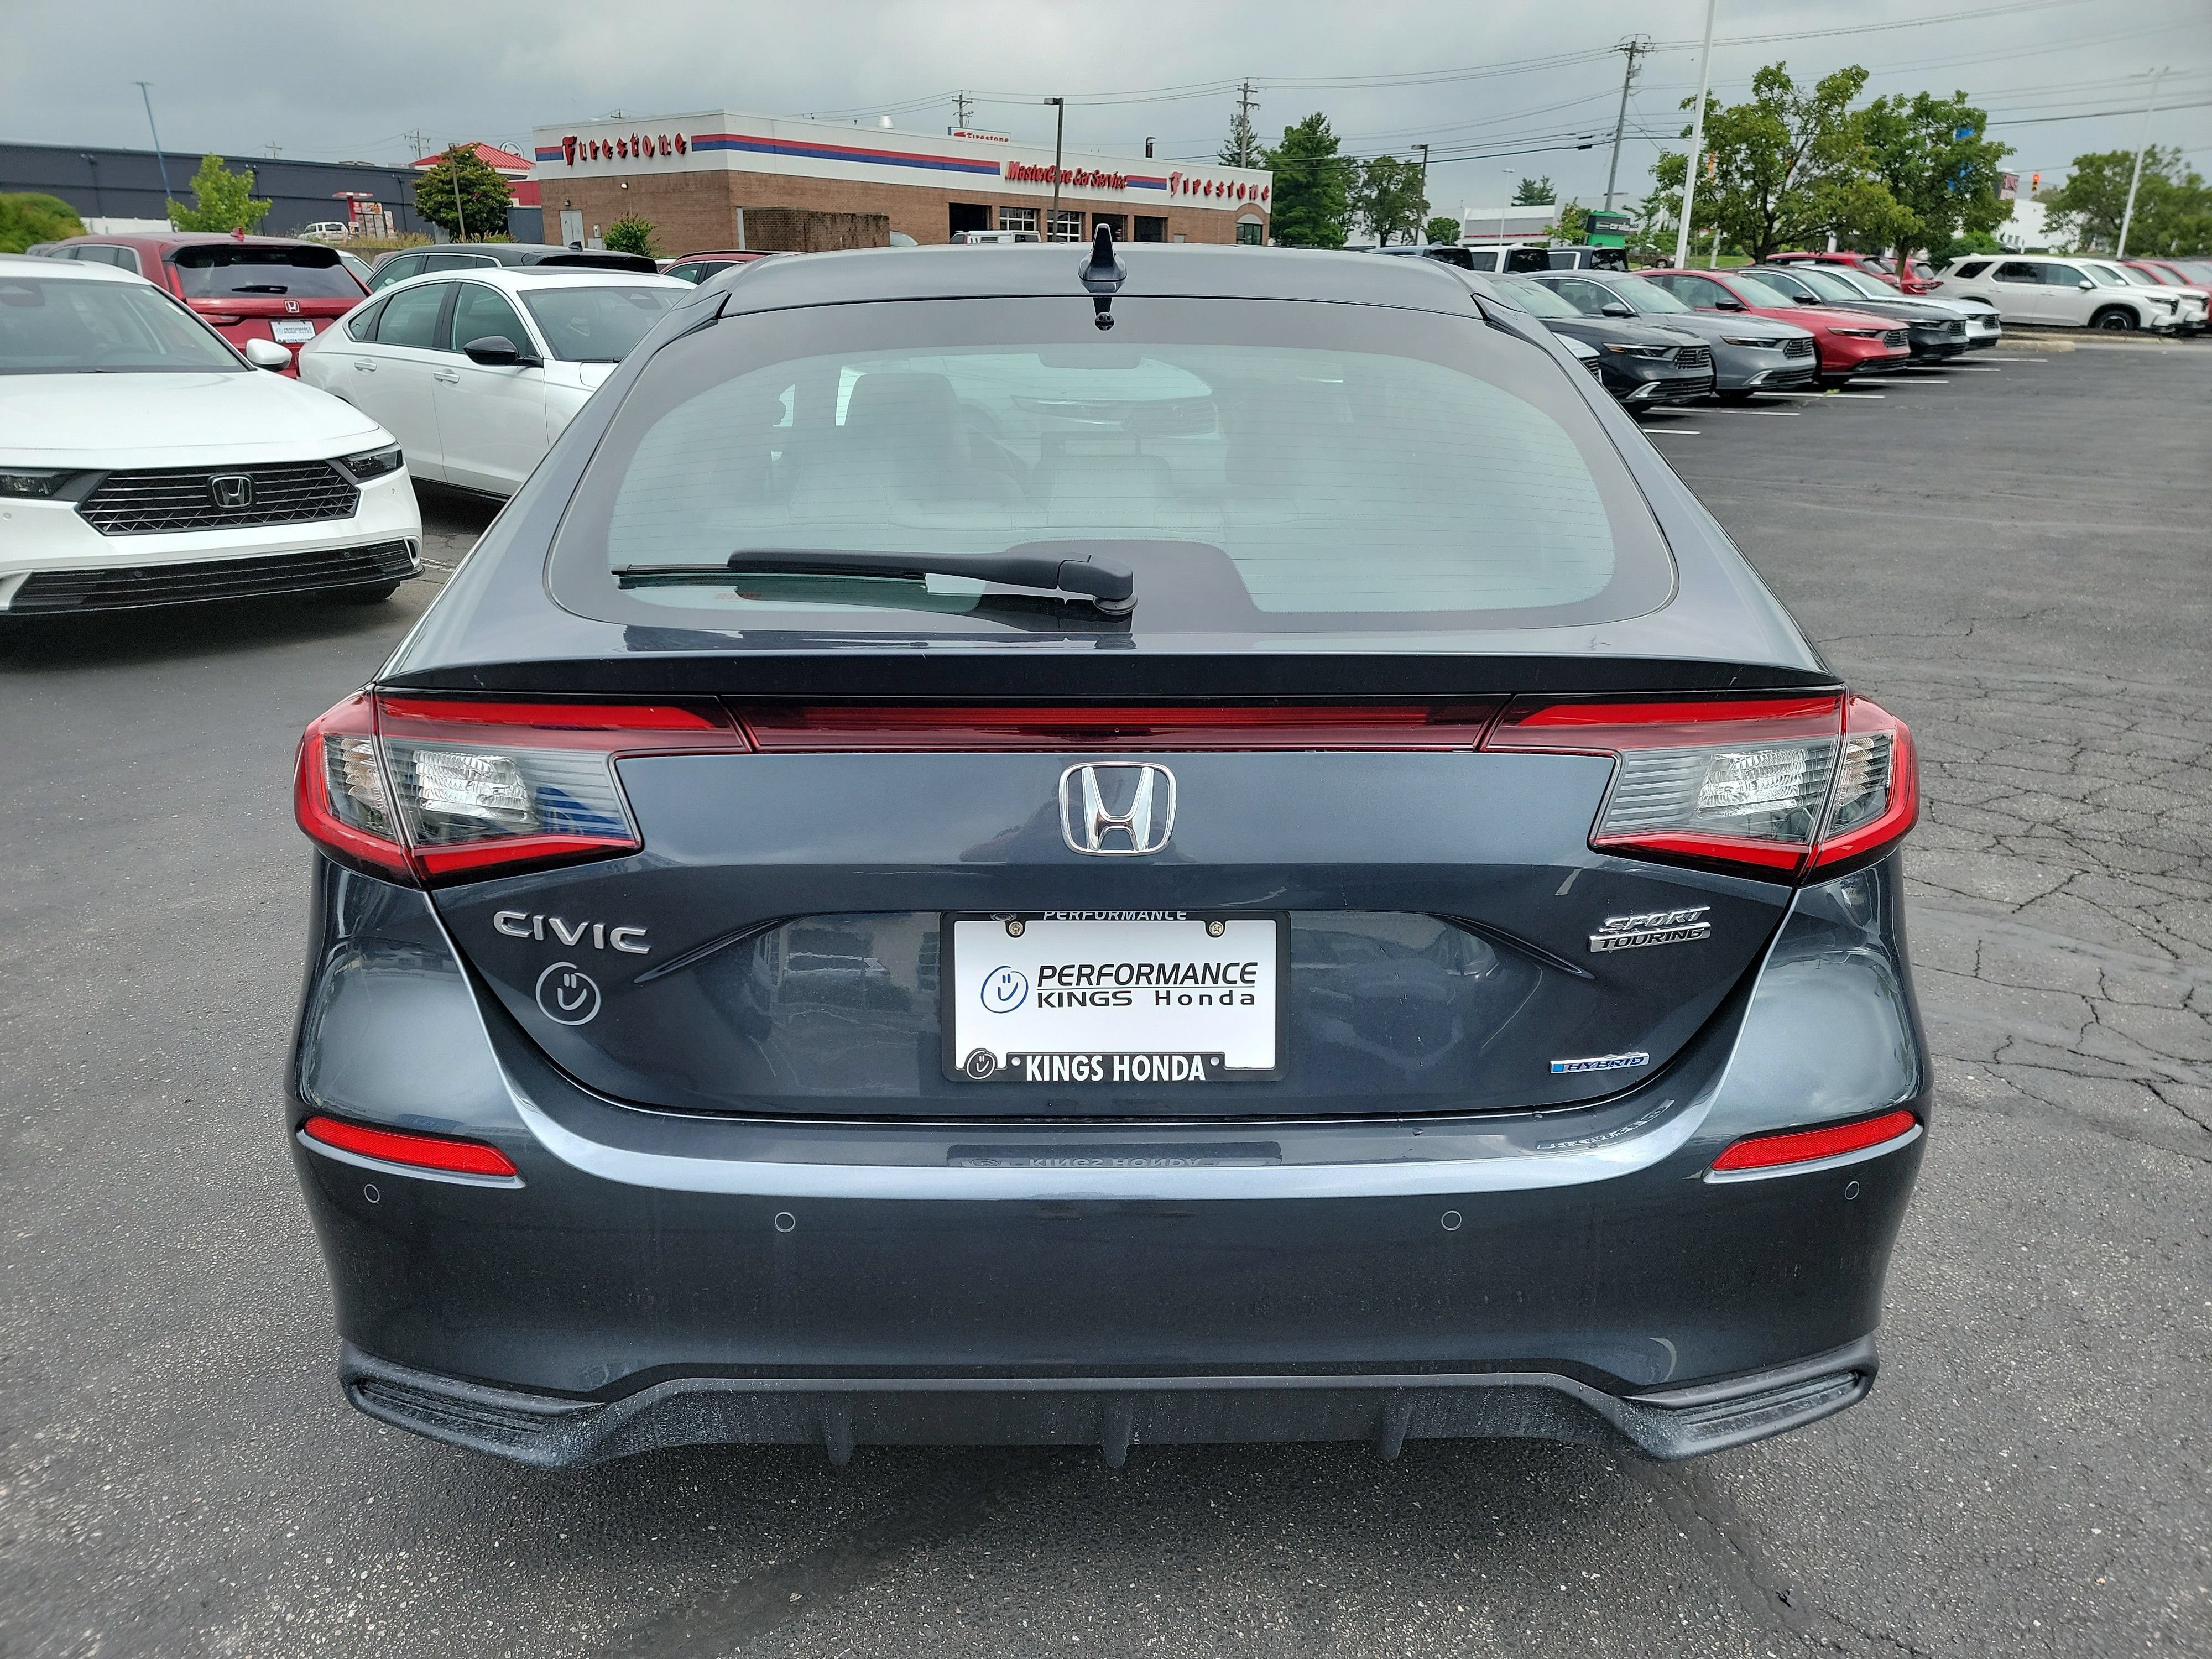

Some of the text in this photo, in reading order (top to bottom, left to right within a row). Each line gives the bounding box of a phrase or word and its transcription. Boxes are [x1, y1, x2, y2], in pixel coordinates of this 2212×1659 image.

[562, 133, 687, 166] Firestone
[1073, 168, 1092, 185] Car
[1091, 169, 1128, 189] Service
[1170, 171, 1270, 200] Firestone
[1598, 905, 1710, 932] SPORT
[493, 910, 651, 954] CIVIC
[1599, 927, 1705, 950] TOURING
[1037, 962, 1258, 987] PERFORMANCE
[1037, 990, 1255, 1008] KINGS Honda
[1026, 1055, 1206, 1081] KINGS HONDA
[1567, 1057, 1644, 1071] HYBRID
